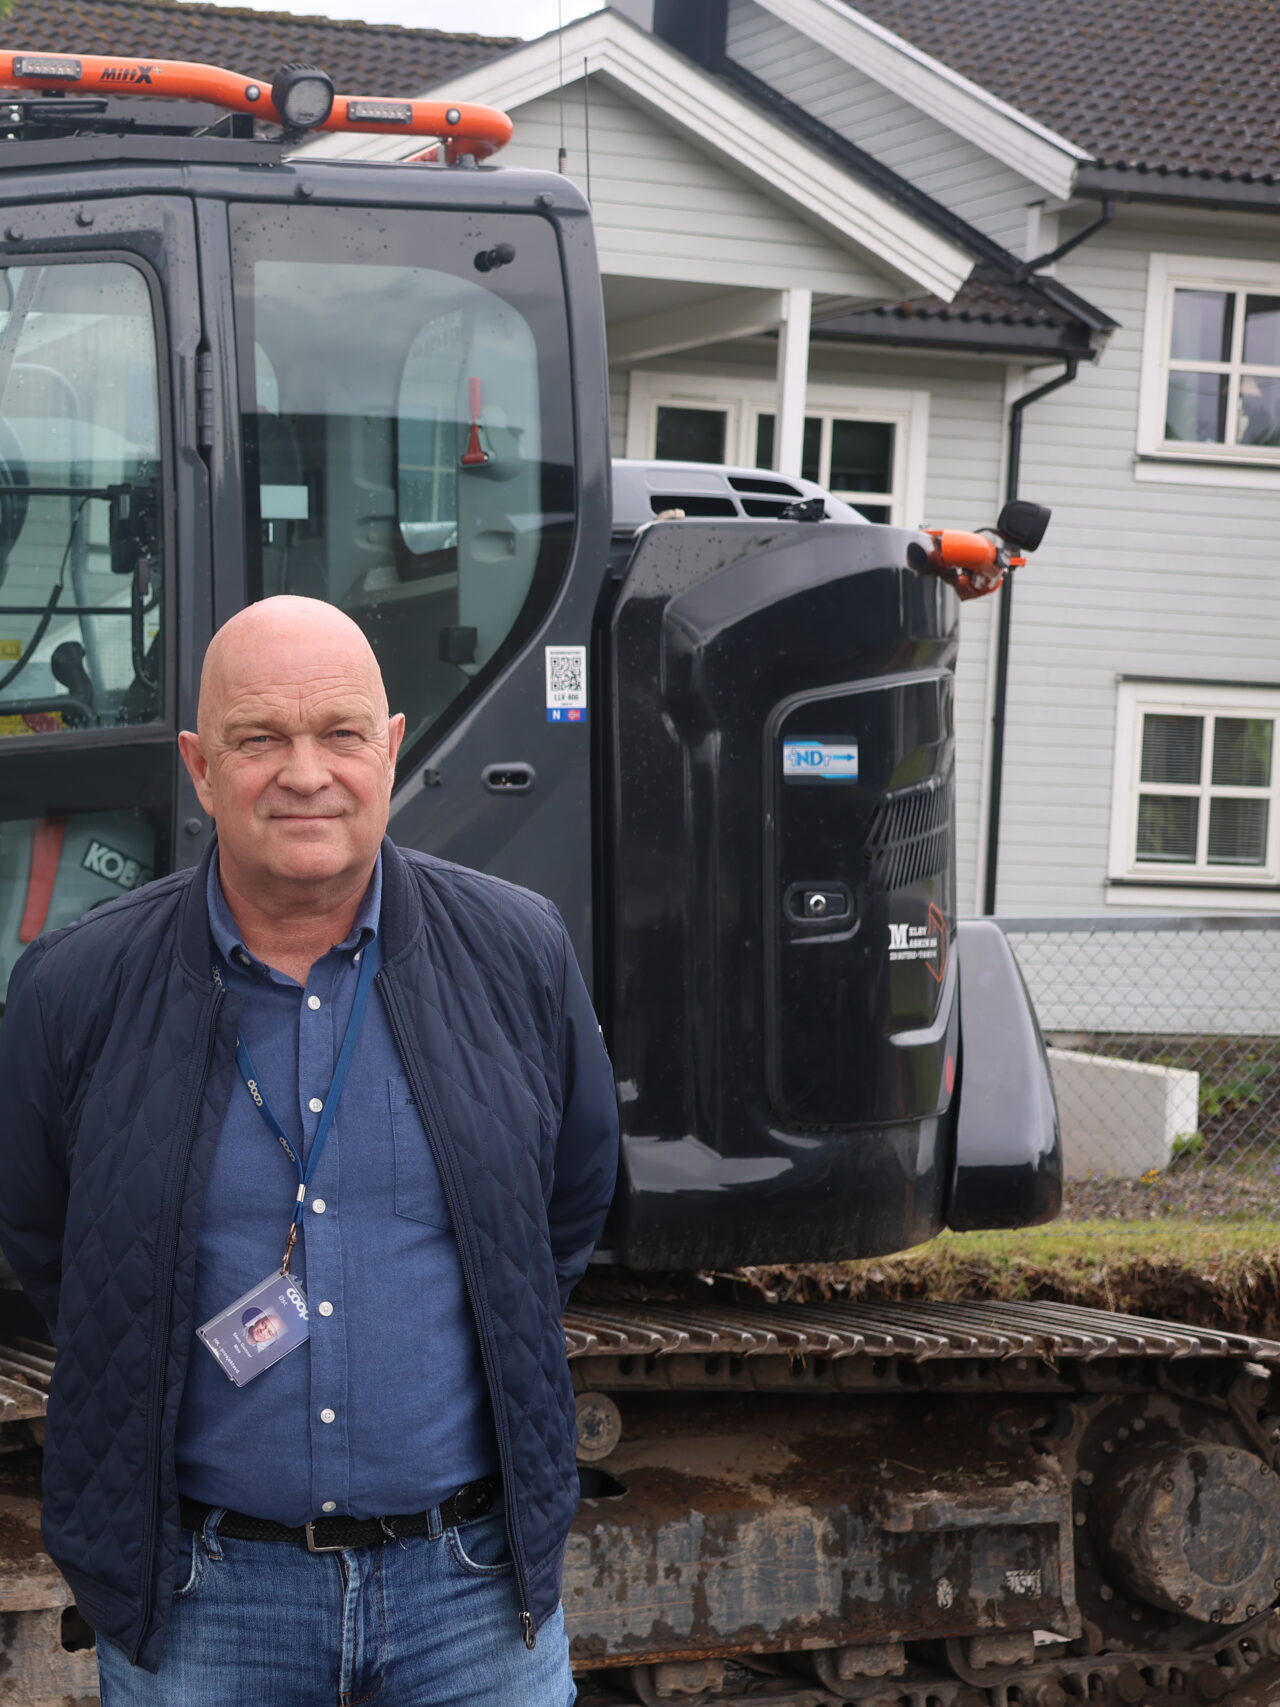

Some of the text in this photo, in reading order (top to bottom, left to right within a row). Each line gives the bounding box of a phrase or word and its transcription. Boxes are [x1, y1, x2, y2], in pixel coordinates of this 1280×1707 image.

[552, 709, 561, 721] N
[83, 841, 150, 888] KOB
[248, 1080, 263, 1106] coop
[280, 1137, 296, 1162] coop
